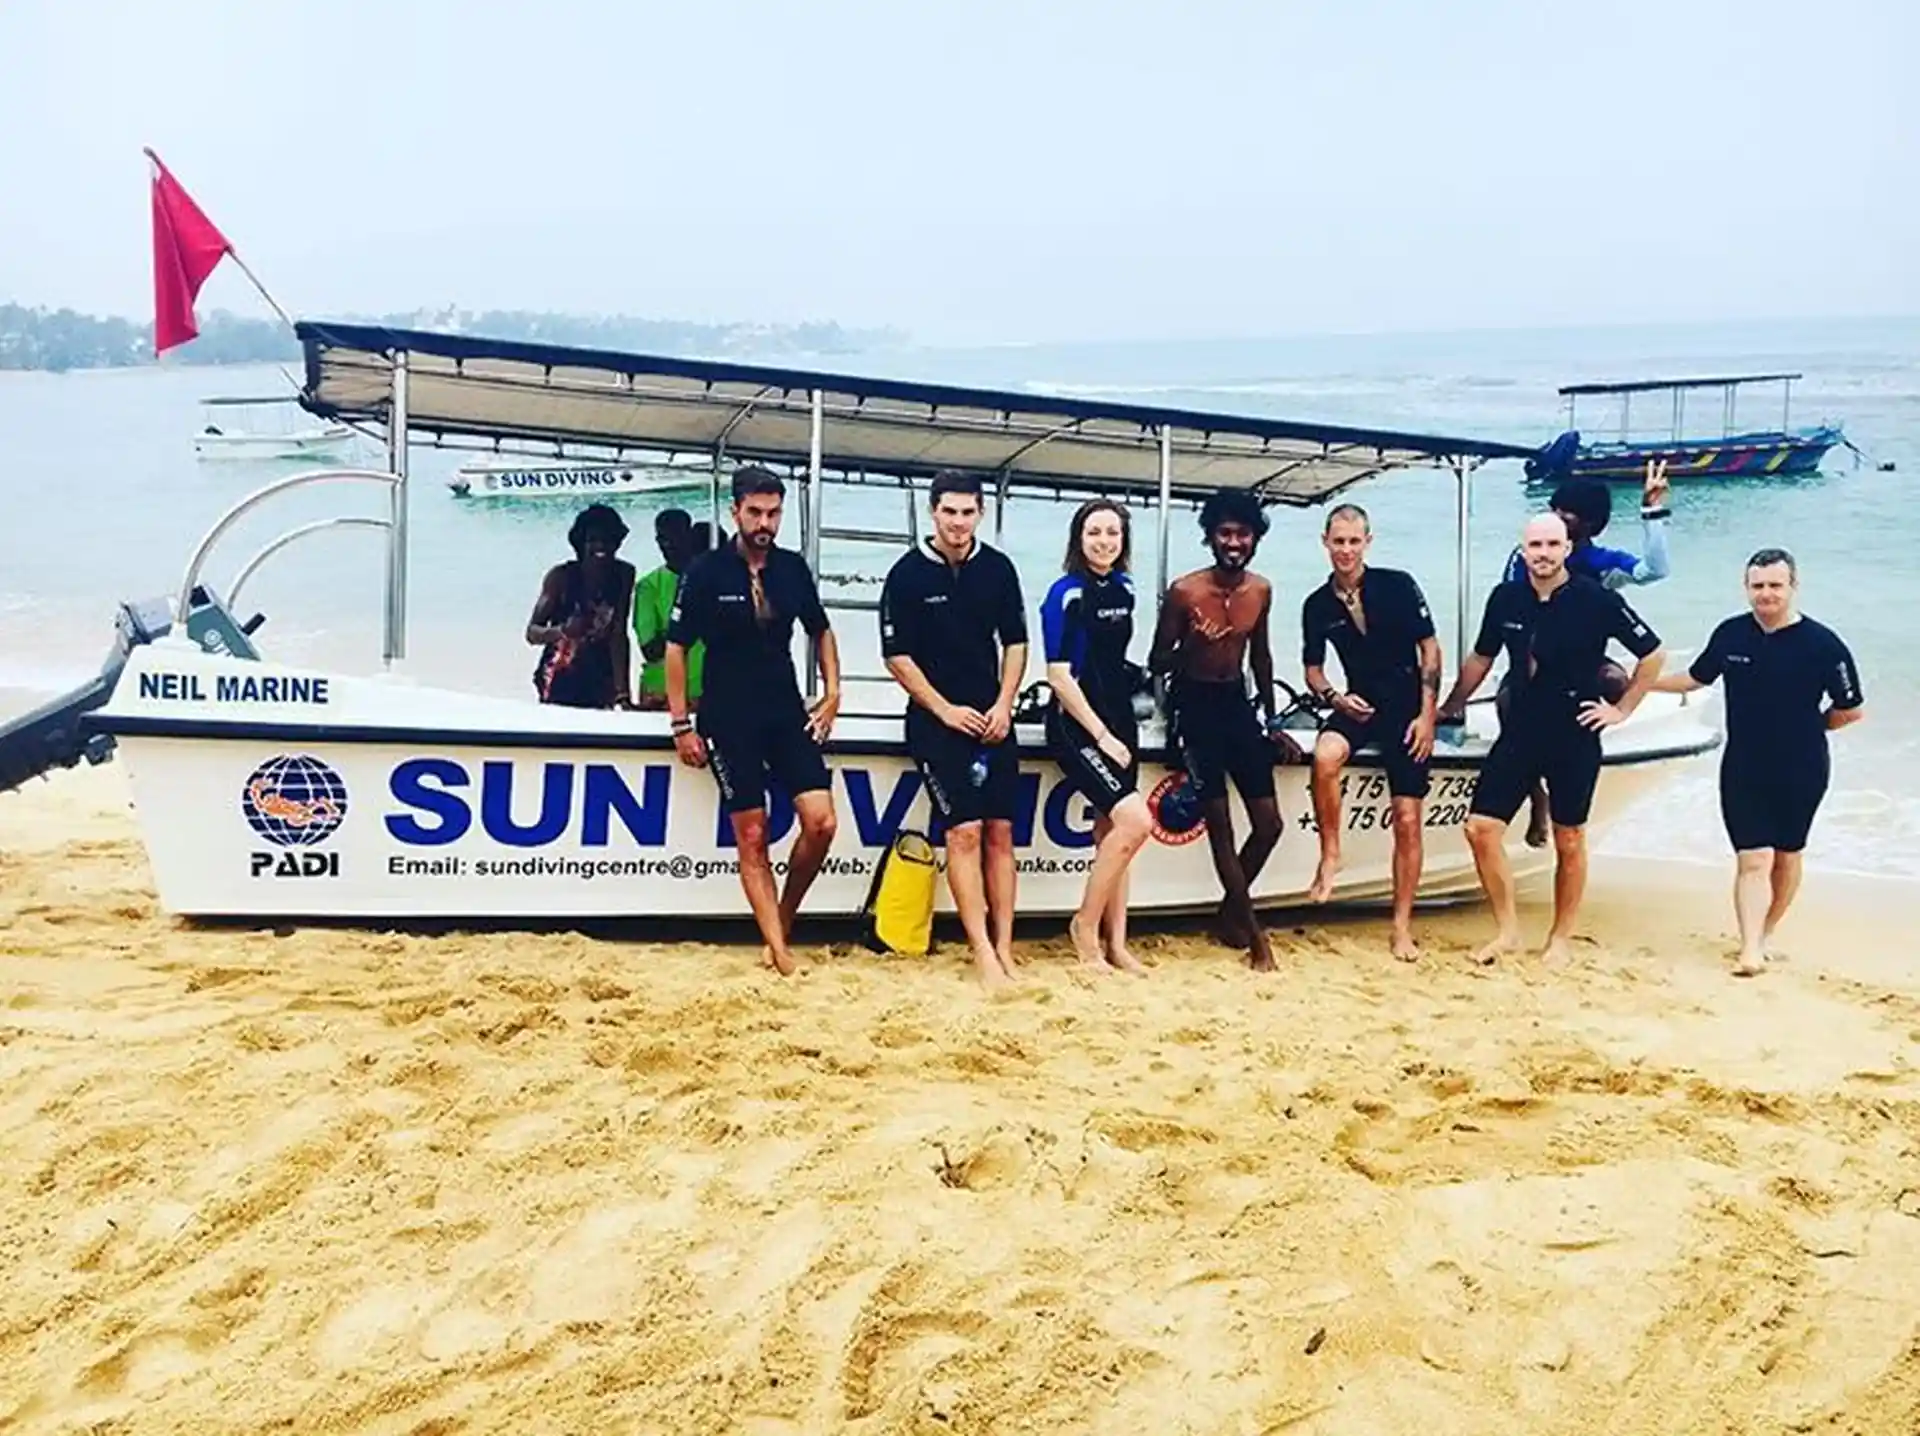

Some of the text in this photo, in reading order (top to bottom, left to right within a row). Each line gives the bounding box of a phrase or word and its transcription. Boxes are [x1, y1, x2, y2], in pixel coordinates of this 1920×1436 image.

[500, 470, 616, 488] SUN DIVING
[140, 672, 329, 704] NEIL MARINE
[384, 758, 672, 847] SUN
[251, 853, 339, 877] PADI
[388, 856, 467, 876] Email:
[820, 857, 872, 875] Web:
